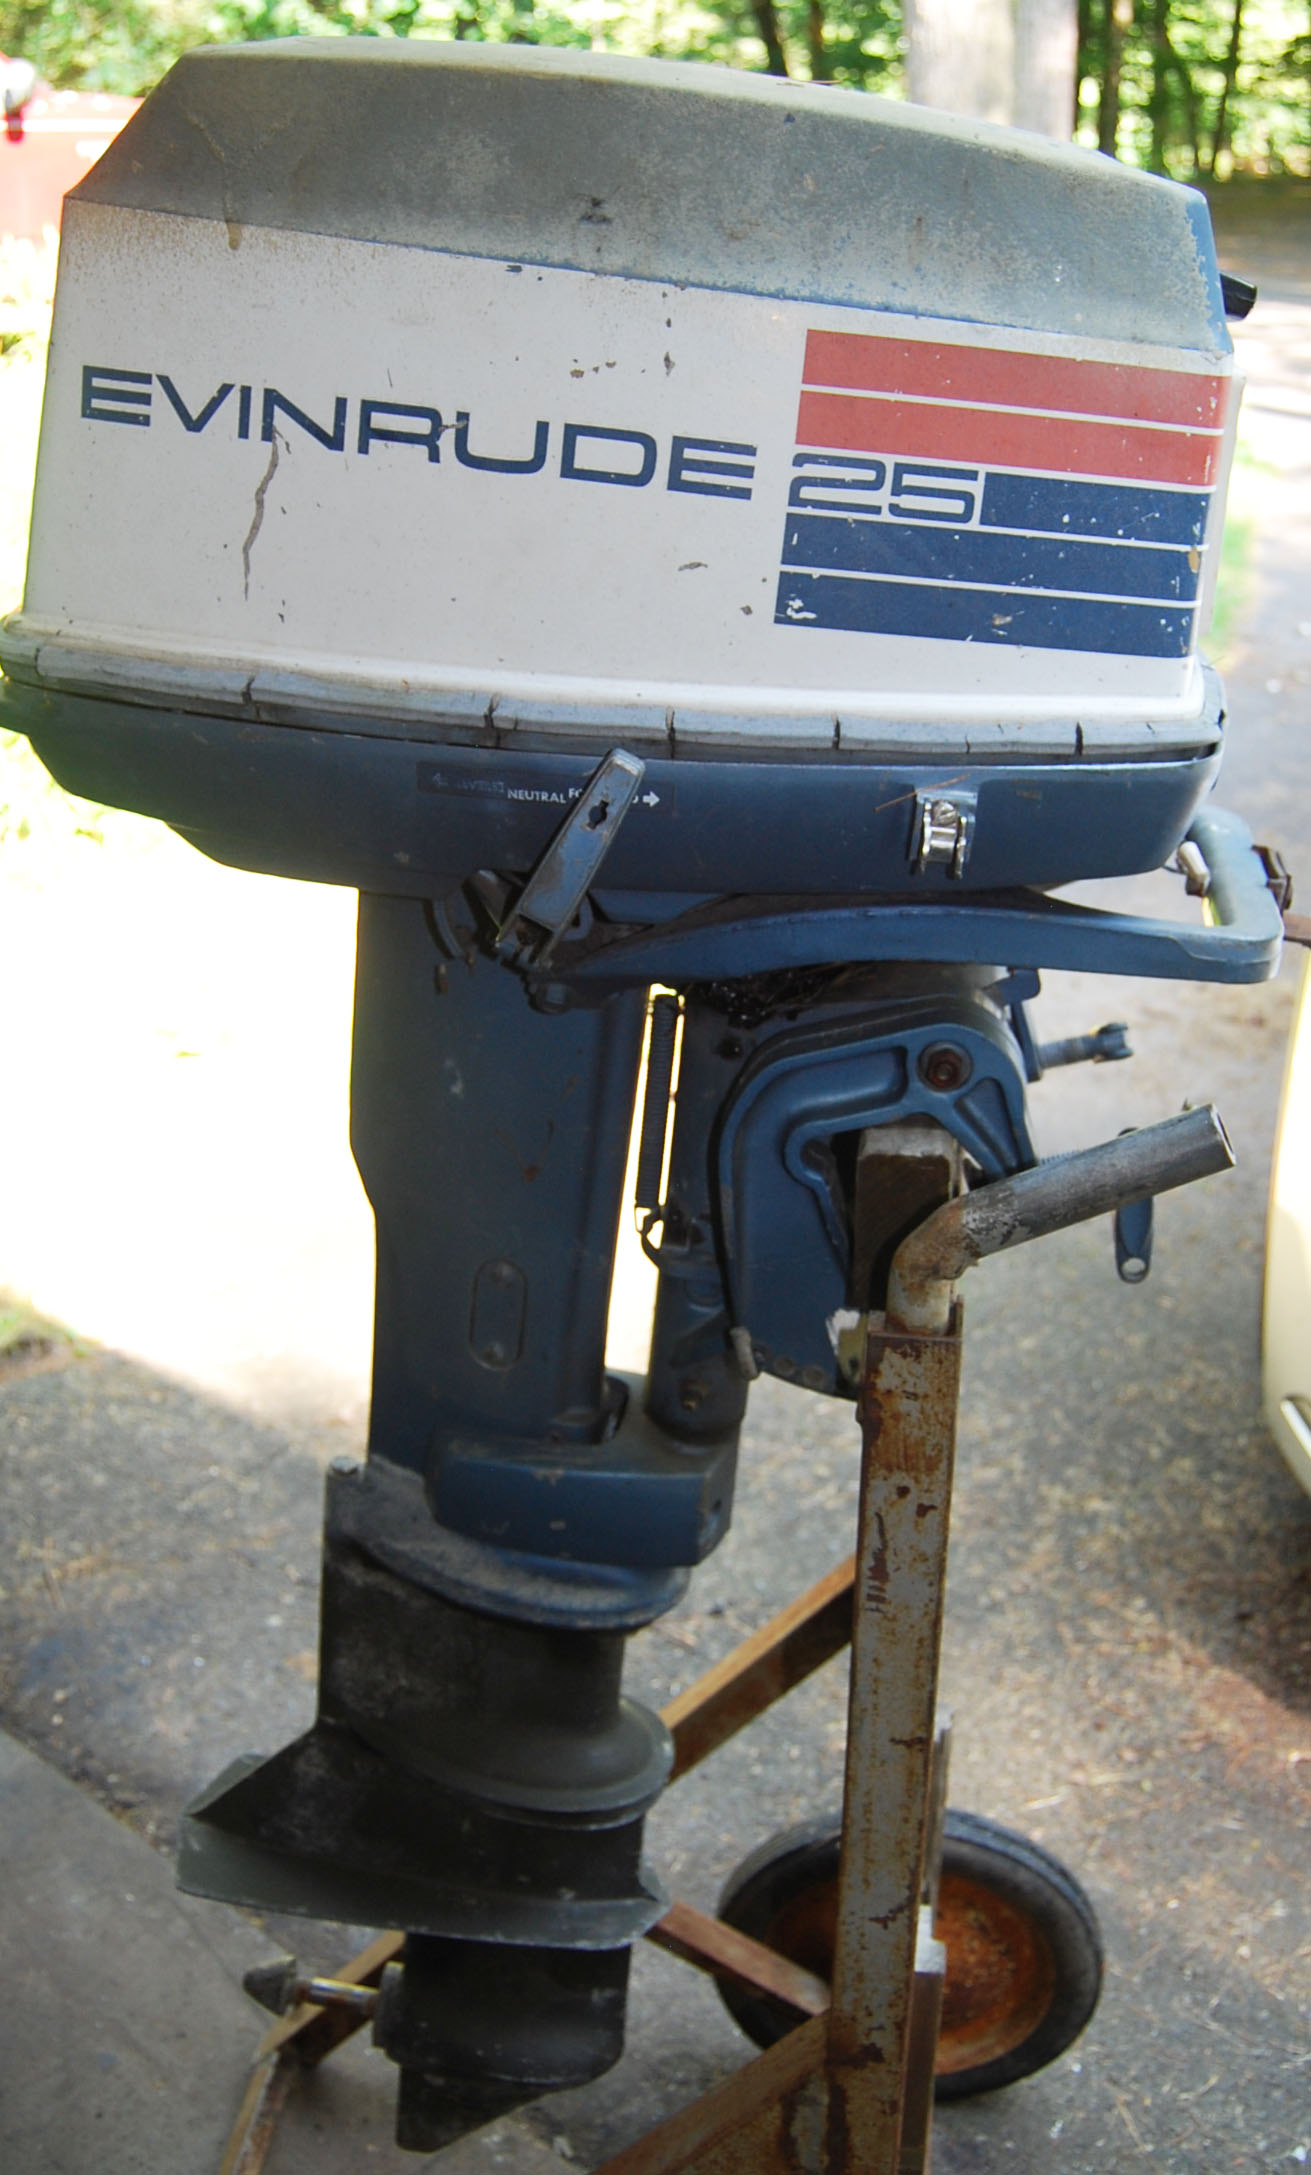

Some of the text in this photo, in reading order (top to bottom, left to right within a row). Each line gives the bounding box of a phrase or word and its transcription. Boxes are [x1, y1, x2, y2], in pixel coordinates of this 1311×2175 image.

[81, 365, 979, 525] EVINRUDE 25
[507, 788, 566, 804] NEUTRAL
